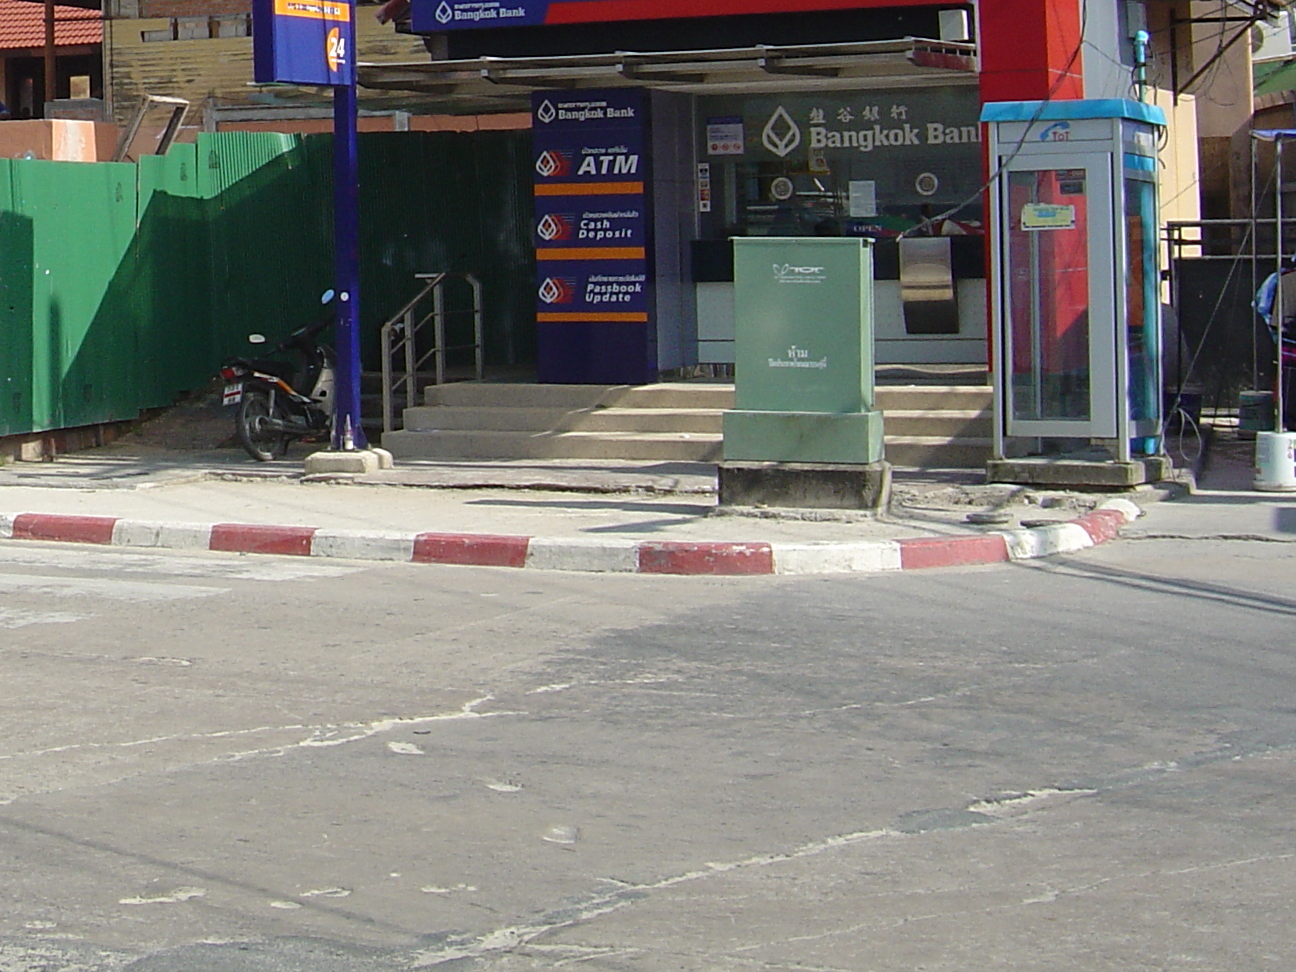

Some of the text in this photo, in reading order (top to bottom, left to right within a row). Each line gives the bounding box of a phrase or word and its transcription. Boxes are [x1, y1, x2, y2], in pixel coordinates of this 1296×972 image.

[454, 7, 526, 21] Bangkok Bank
[329, 37, 345, 57] 24
[558, 107, 635, 121] Bangkok Bank
[809, 124, 920, 152] Bangkok
[577, 154, 639, 176] ATM
[580, 219, 610, 229] Cash
[578, 228, 632, 240] Deposit
[587, 282, 642, 292] Passbook
[585, 292, 631, 304] Update
[788, 345, 808, 358] ห้าม
